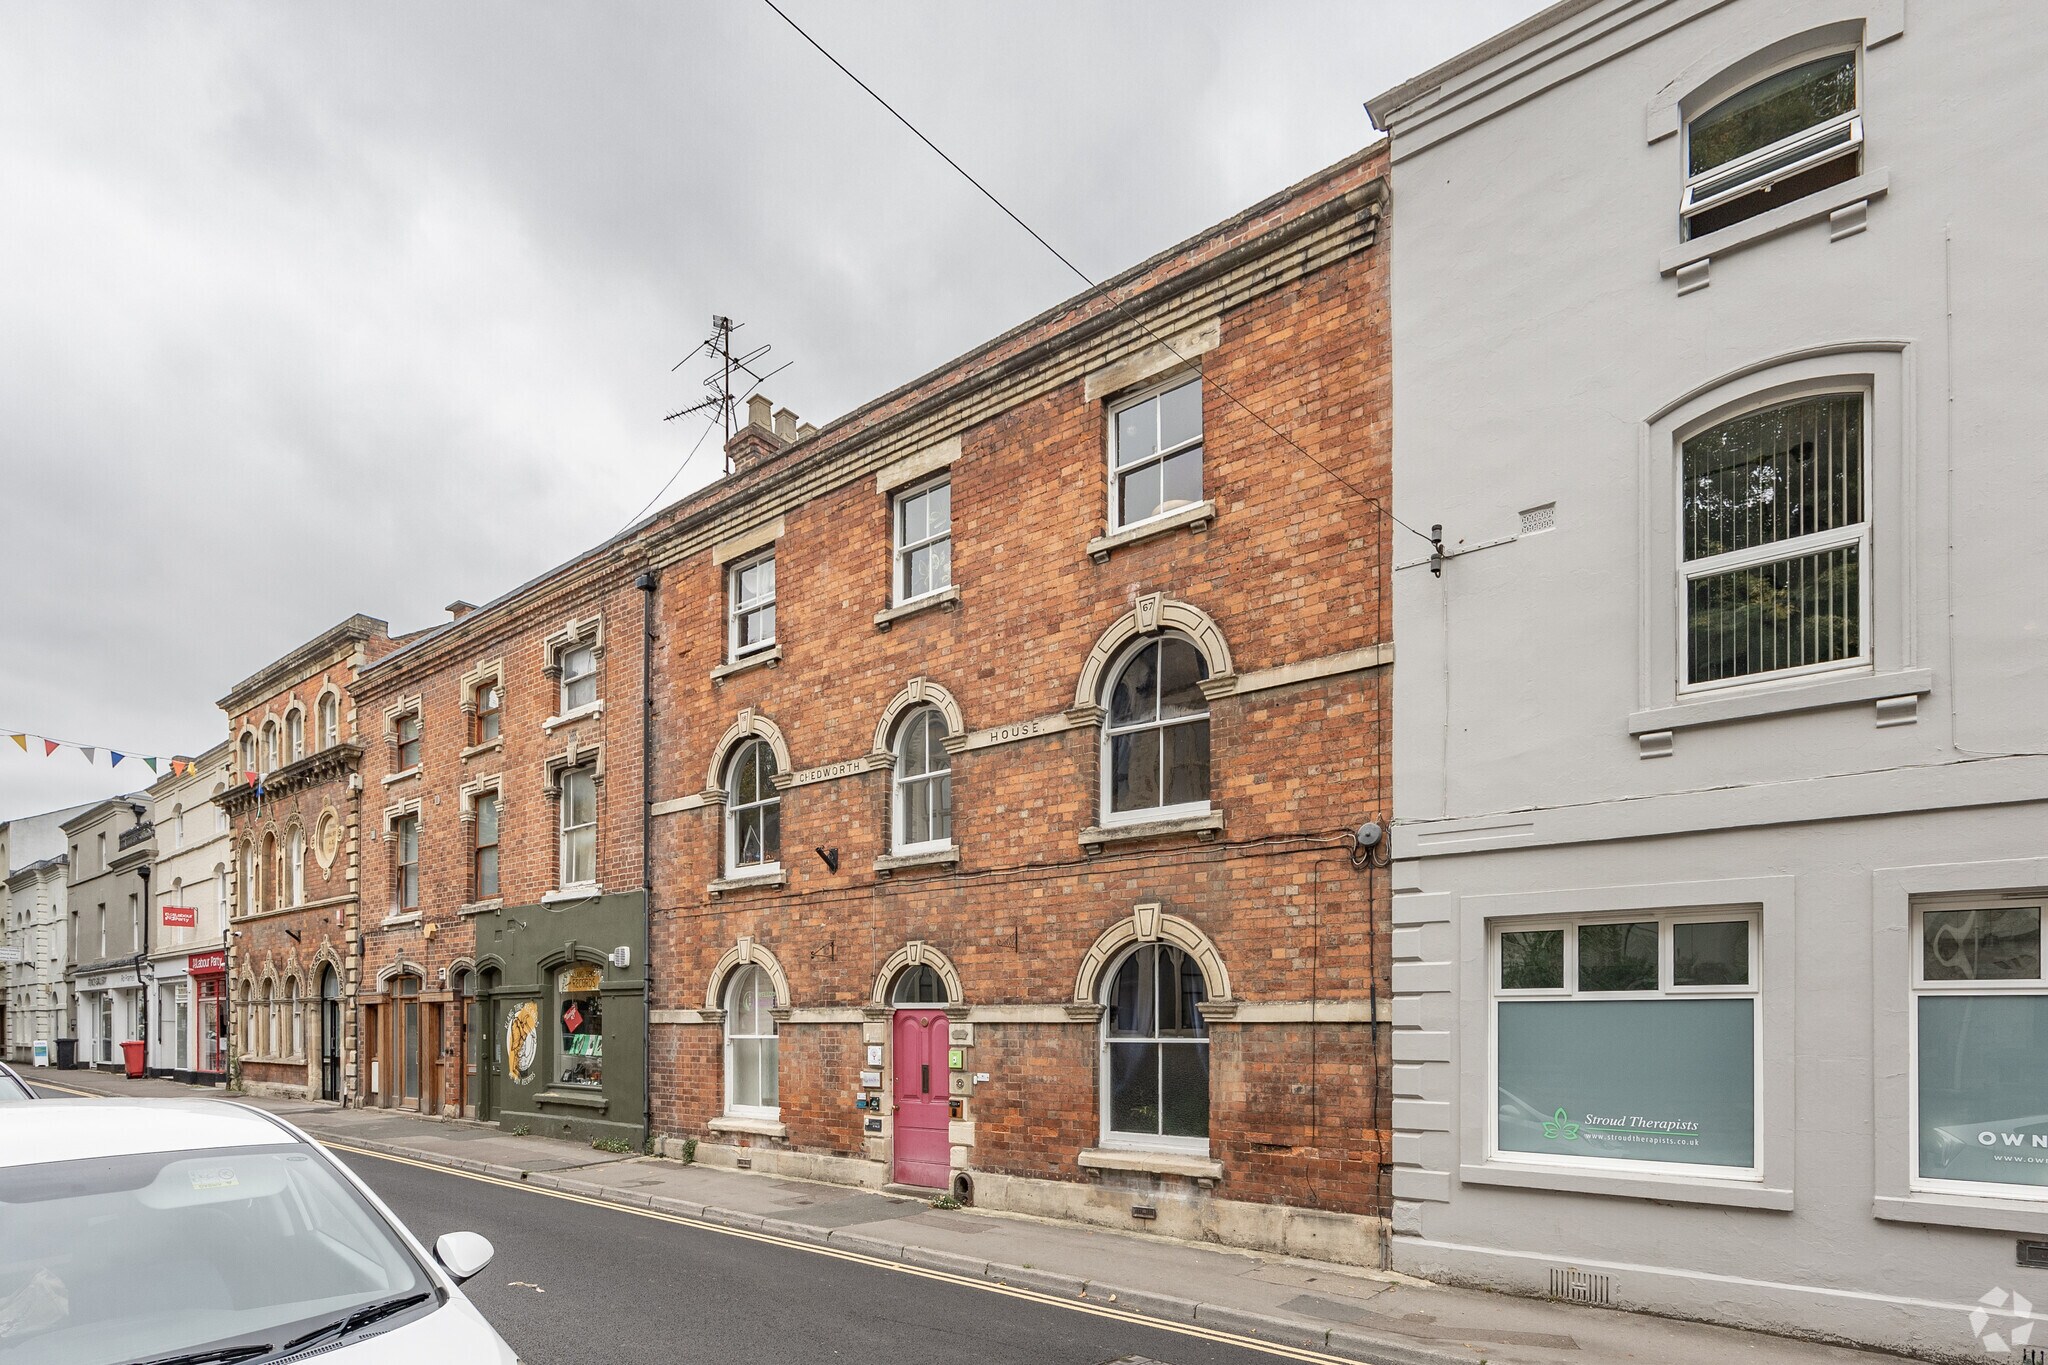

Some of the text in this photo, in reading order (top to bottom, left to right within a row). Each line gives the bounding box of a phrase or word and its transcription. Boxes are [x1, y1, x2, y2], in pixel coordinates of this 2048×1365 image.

[1143, 602, 1153, 611] 67
[799, 722, 1045, 782] CHEDWORTH HOUSE.
[571, 978, 596, 988] RECORDS
[1585, 1114, 1698, 1131] Stroud Therapists
[1584, 1134, 1699, 1146] www.stroudtherapists.co.uk
[1978, 1131, 2048, 1148] OWN
